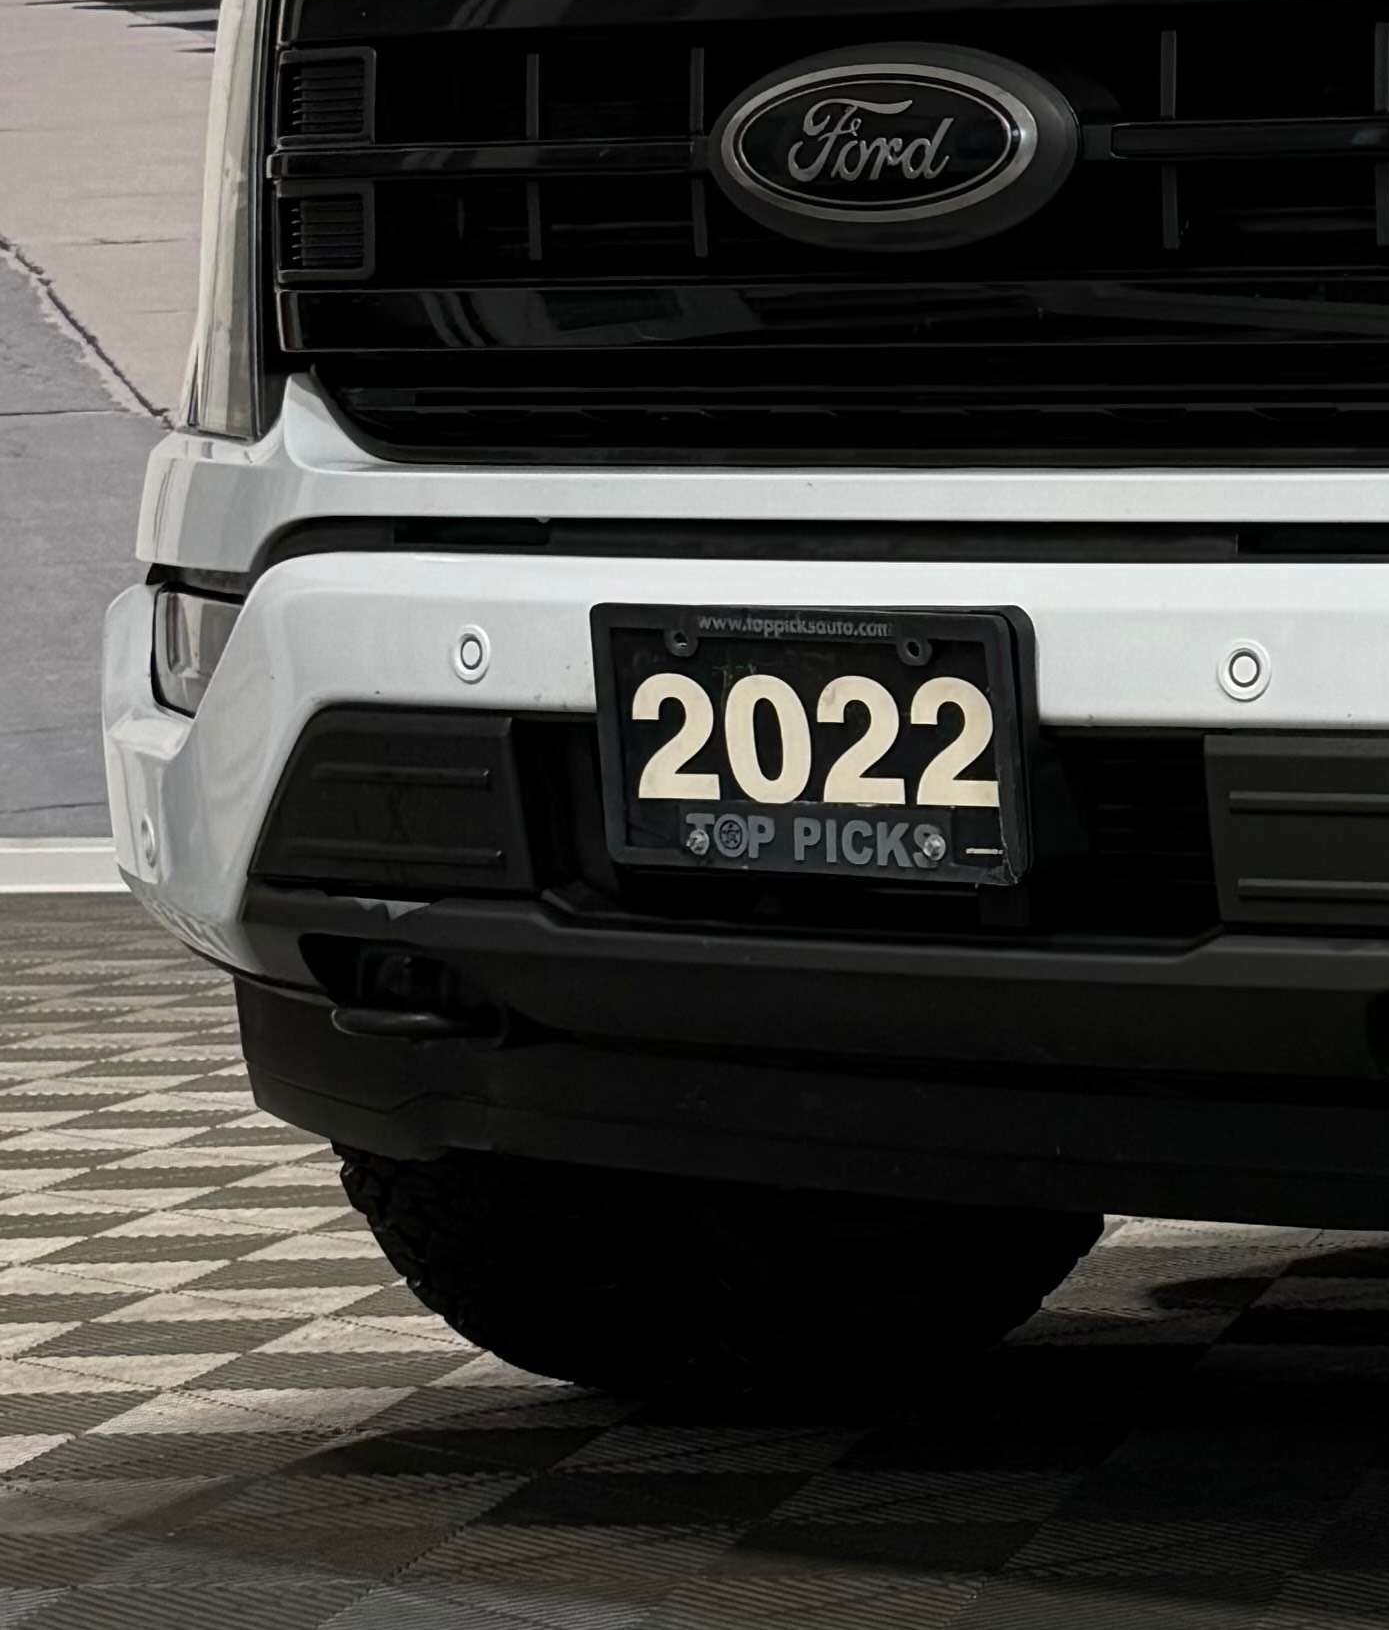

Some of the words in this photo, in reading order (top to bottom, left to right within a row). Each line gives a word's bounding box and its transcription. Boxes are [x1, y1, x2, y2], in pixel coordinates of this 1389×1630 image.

[787, 97, 955, 183] Ford
[631, 671, 1000, 807] 2022
[685, 812, 775, 860] TOP
[794, 816, 945, 869] PICKS
